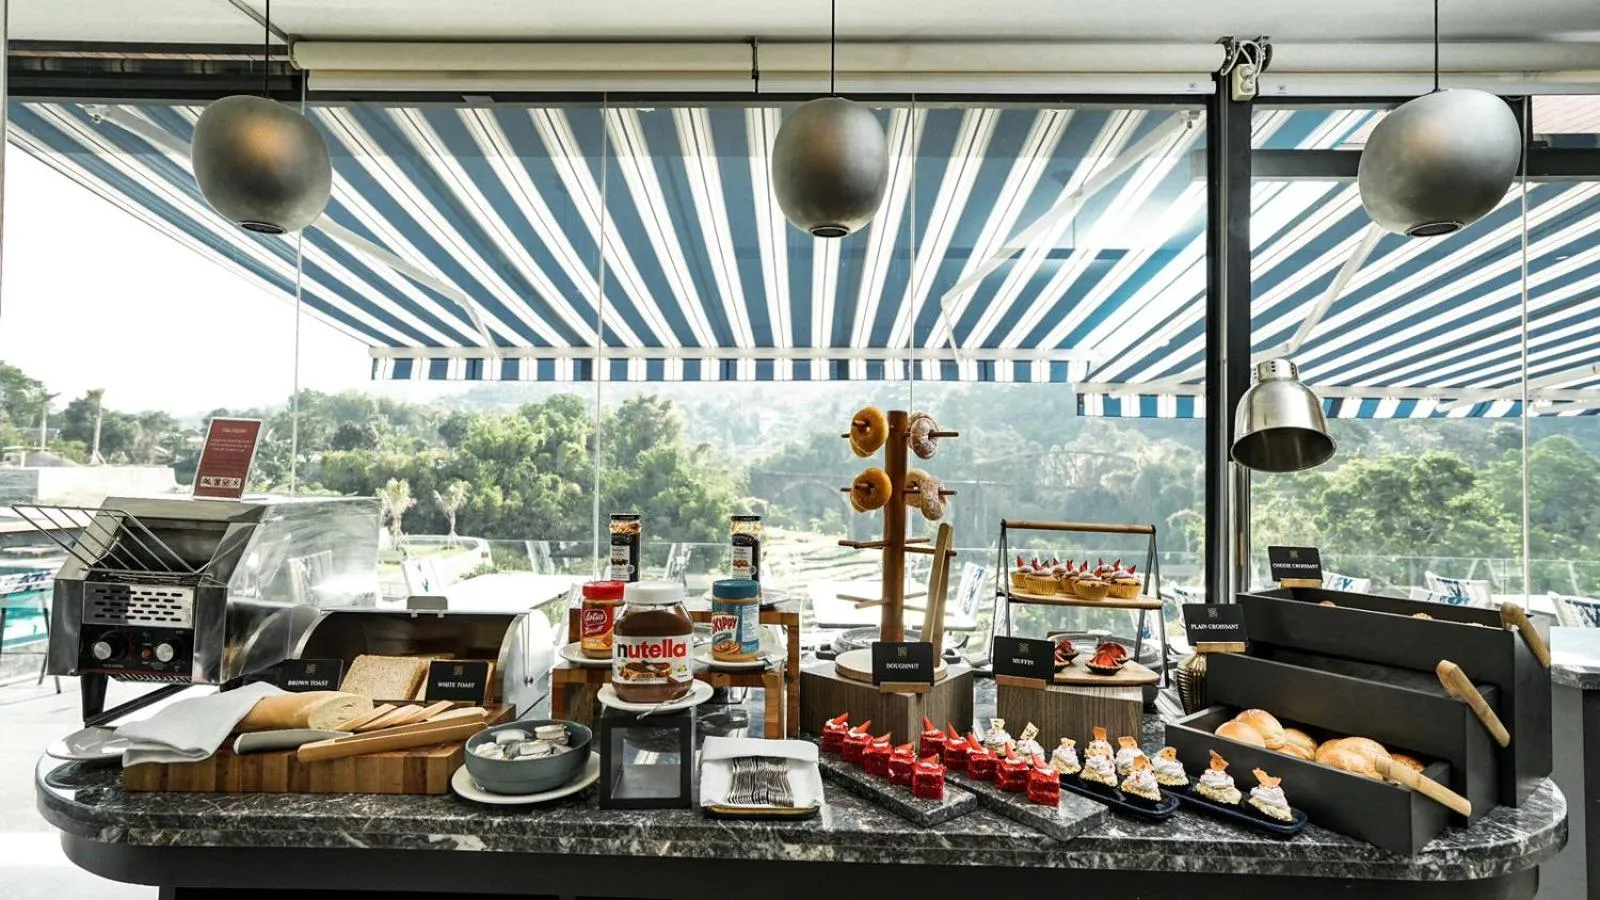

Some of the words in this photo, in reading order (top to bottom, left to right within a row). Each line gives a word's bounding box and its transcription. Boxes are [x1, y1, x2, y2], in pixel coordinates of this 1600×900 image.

[617, 639, 687, 659] nutella
[885, 662, 920, 670] DOUGHNUT
[1012, 657, 1034, 666] MUFFIN
